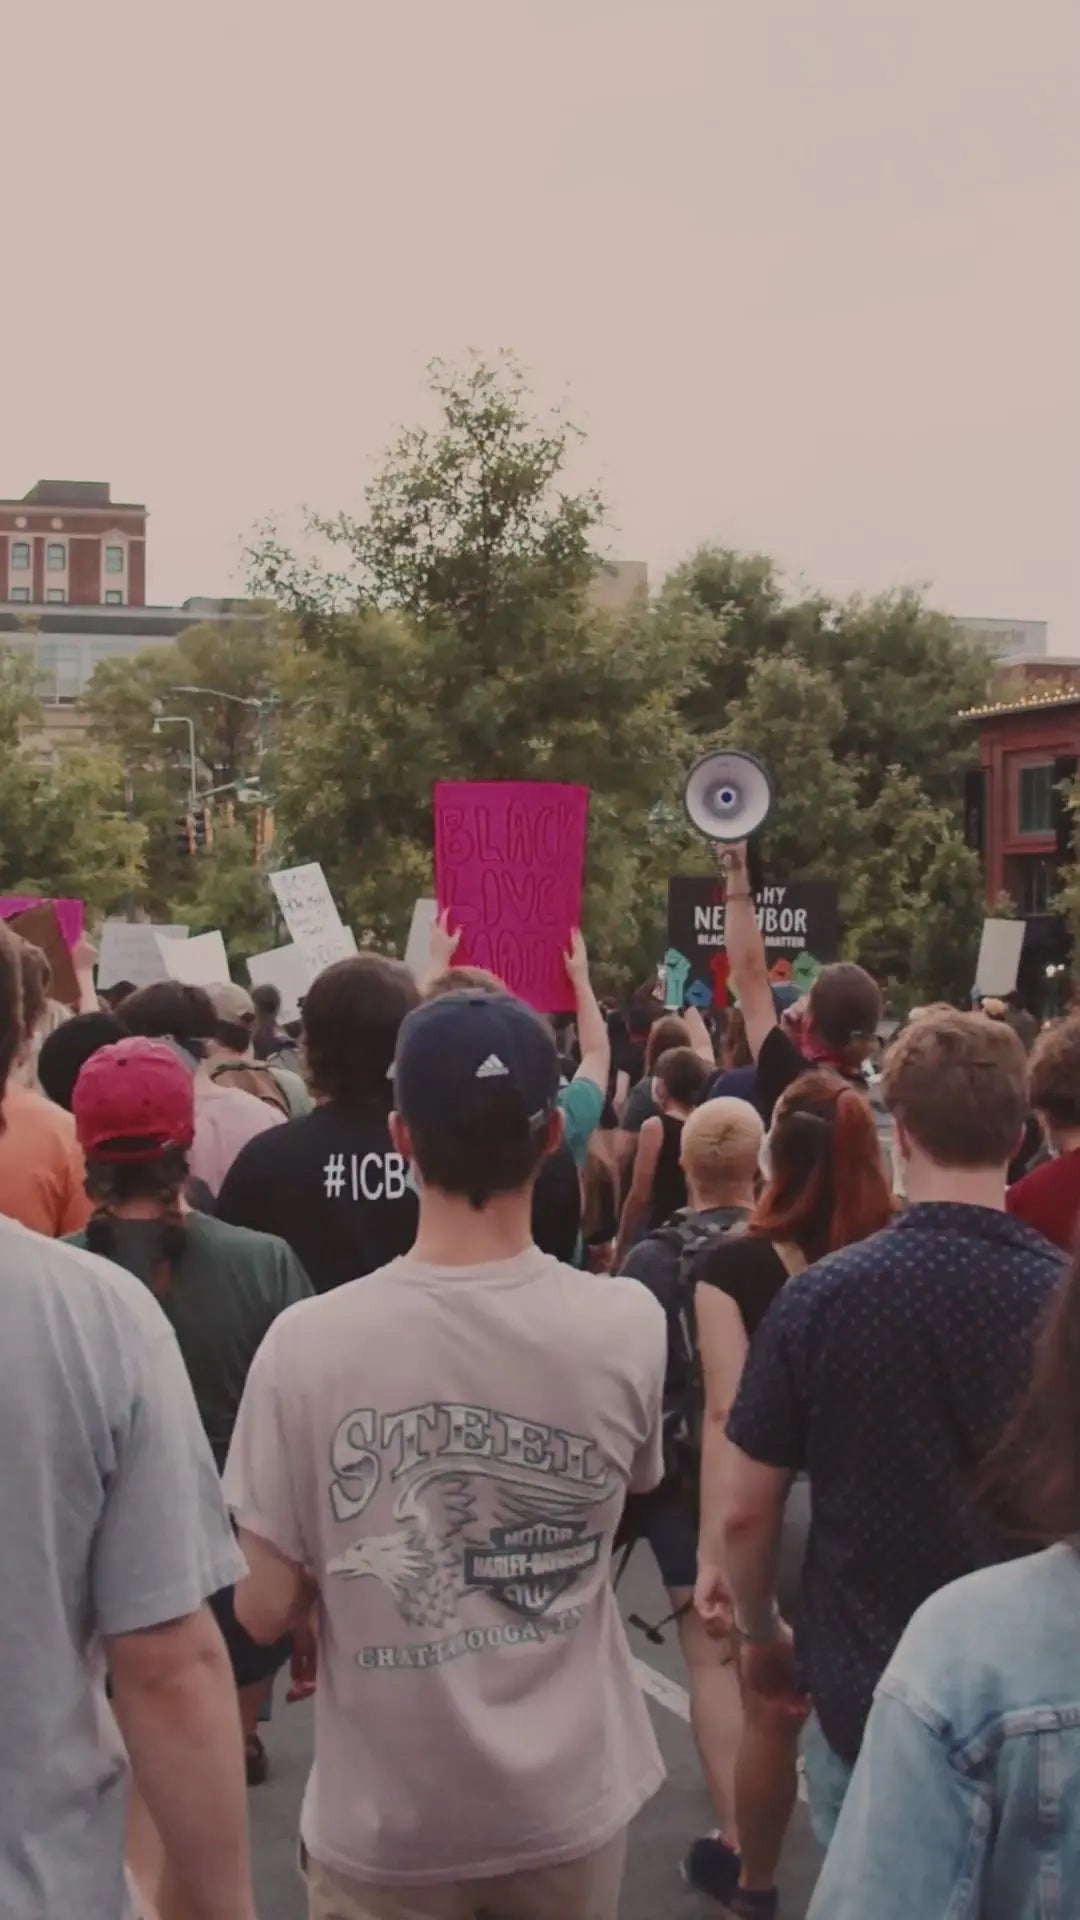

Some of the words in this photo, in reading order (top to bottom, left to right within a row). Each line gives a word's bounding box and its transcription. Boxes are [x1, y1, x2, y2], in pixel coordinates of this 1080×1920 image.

[439, 801, 577, 867] BLACK
[694, 905, 808, 934] NEHBOR
[697, 934, 725, 946] BLAC
[329, 1402, 608, 1523] STEEL
